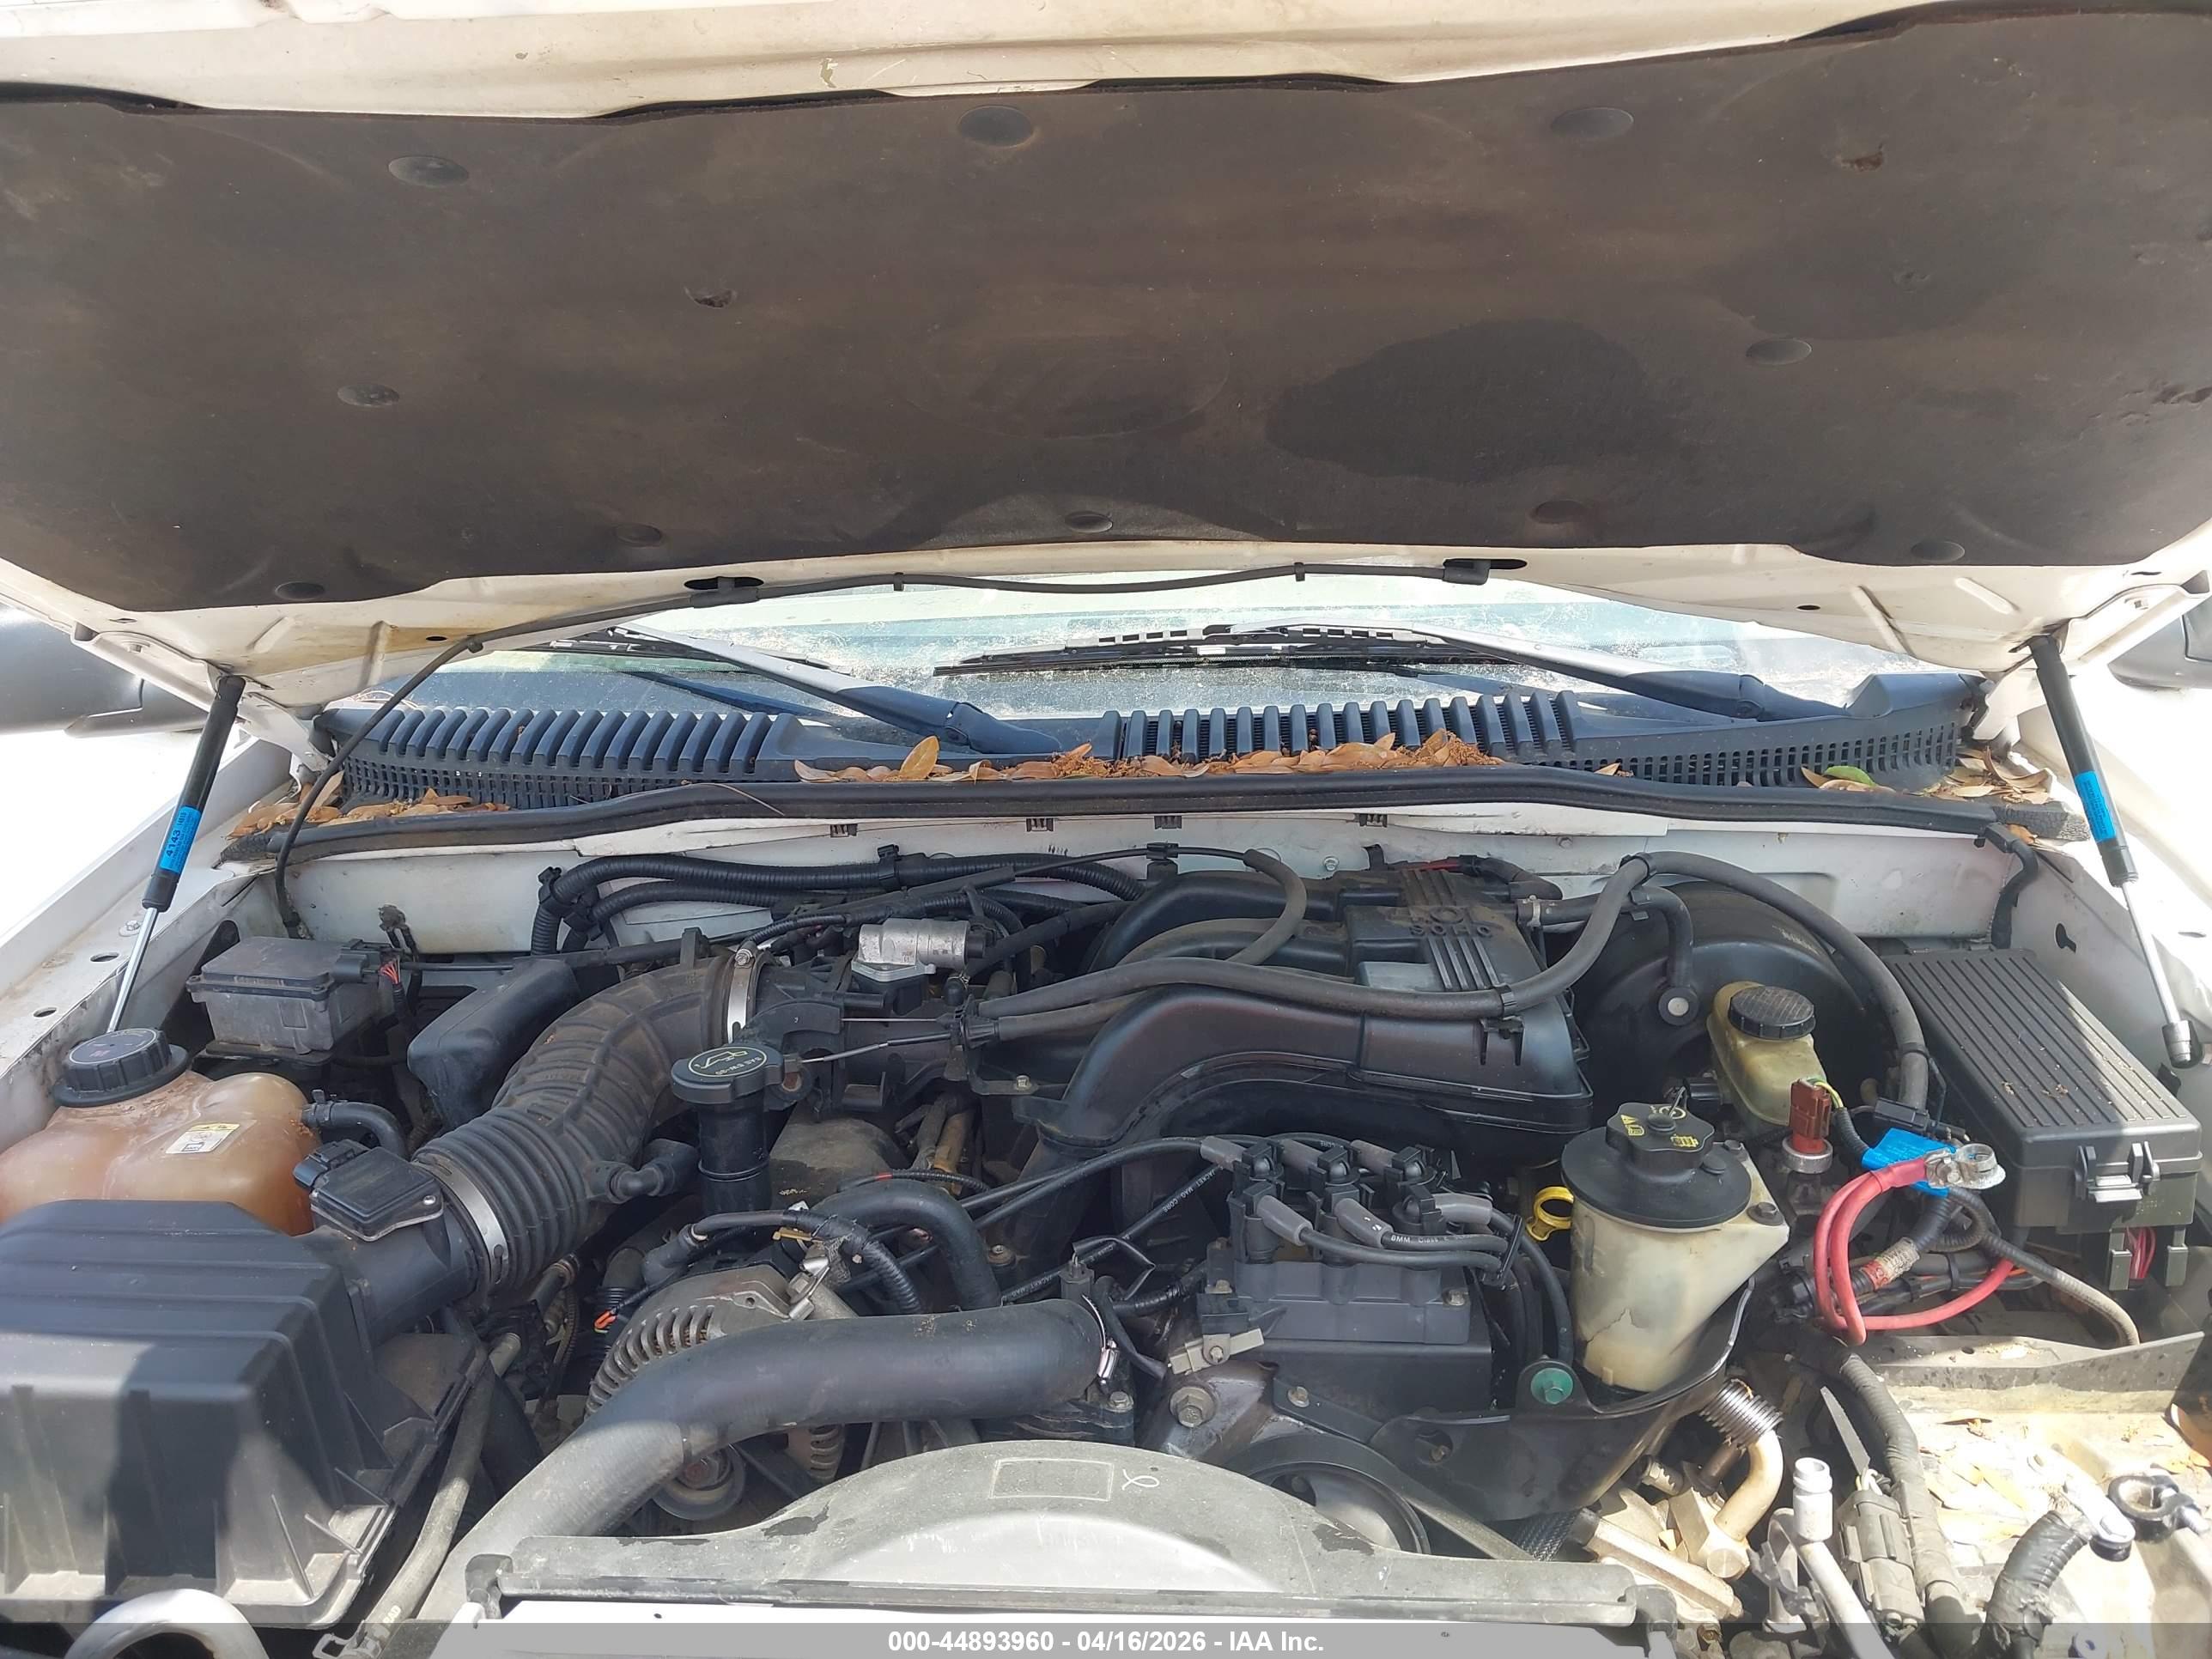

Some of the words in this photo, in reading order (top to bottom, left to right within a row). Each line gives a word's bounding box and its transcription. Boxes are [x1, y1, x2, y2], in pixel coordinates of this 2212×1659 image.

[167, 829, 181, 857] 4143
[1409, 924, 1492, 938] SOHC
[1195, 1169, 1216, 1187] JACKET
[1162, 1198, 1179, 1213] CORE
[1030, 1274, 1053, 1289] JACKET
